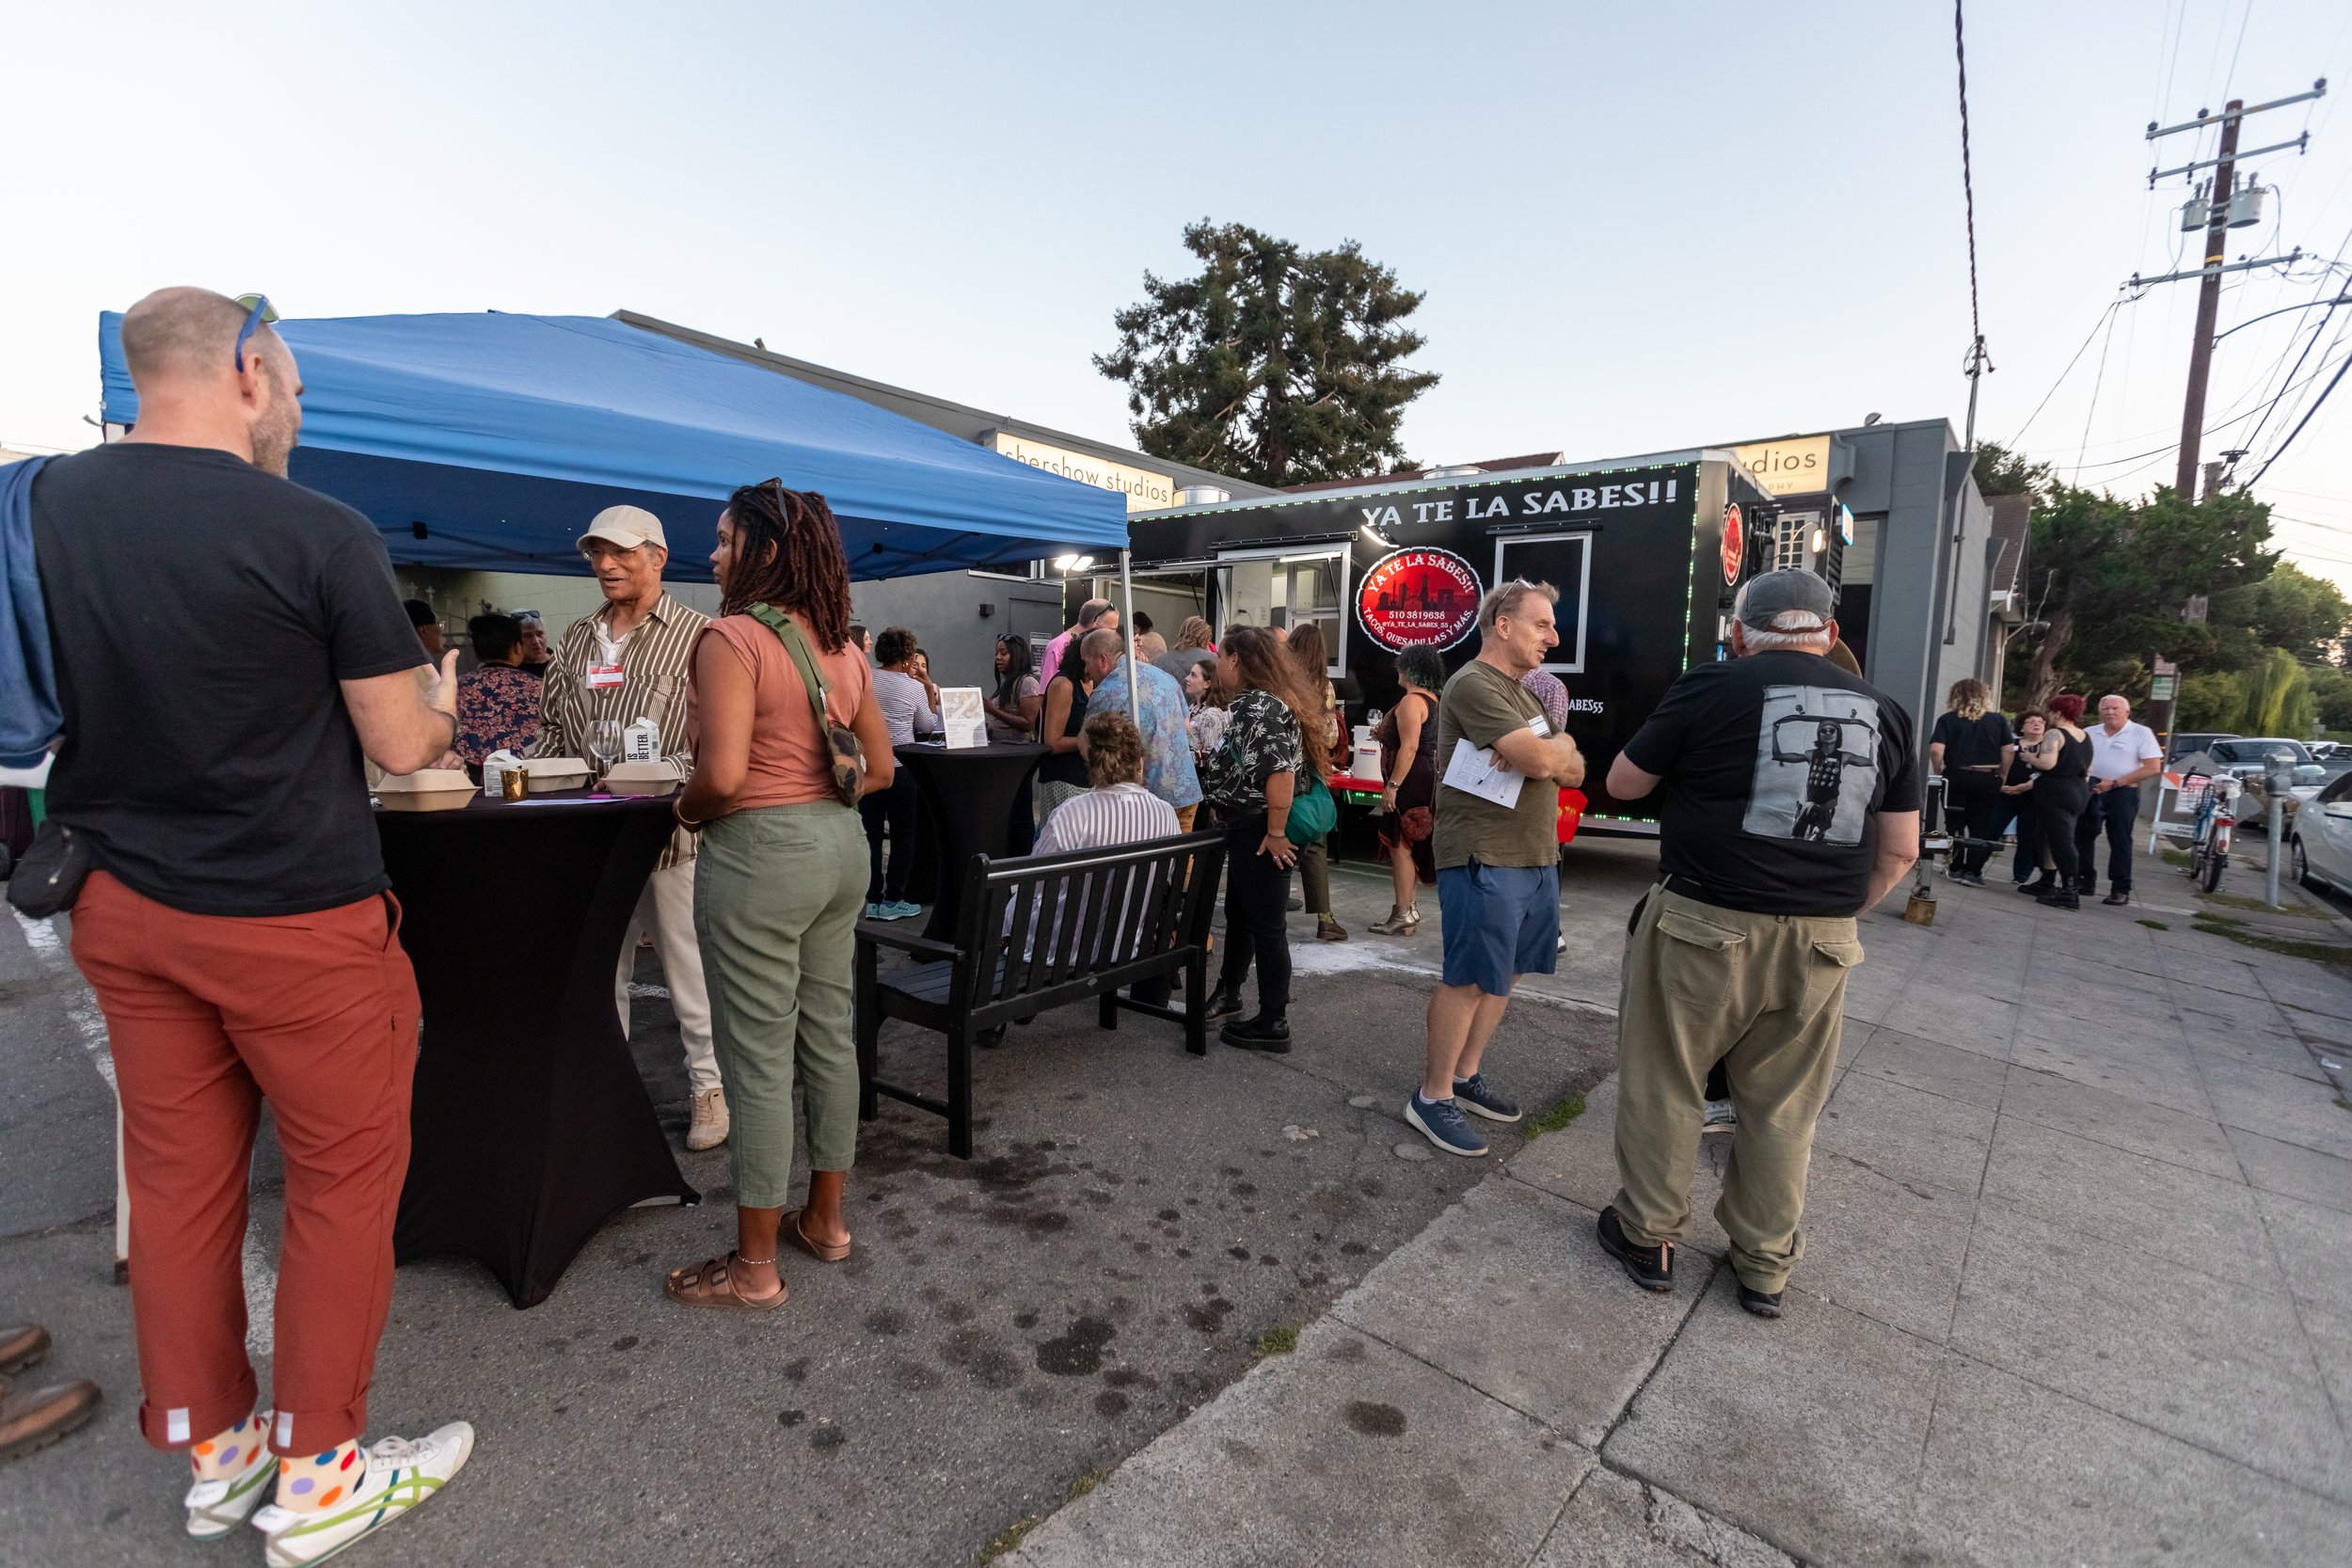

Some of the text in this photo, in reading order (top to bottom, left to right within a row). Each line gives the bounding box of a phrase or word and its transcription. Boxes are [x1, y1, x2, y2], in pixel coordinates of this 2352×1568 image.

[1744, 450, 1817, 473] dios
[1106, 472, 1168, 502] studios
[1361, 480, 1677, 526] YA TE LA SABES!!
[1368, 554, 1474, 593] YA TE LA SABES!!
[1389, 610, 1445, 620] 510 3819638
[1446, 625, 1454, 636] Y
[637, 733, 649, 759] BETTER.
